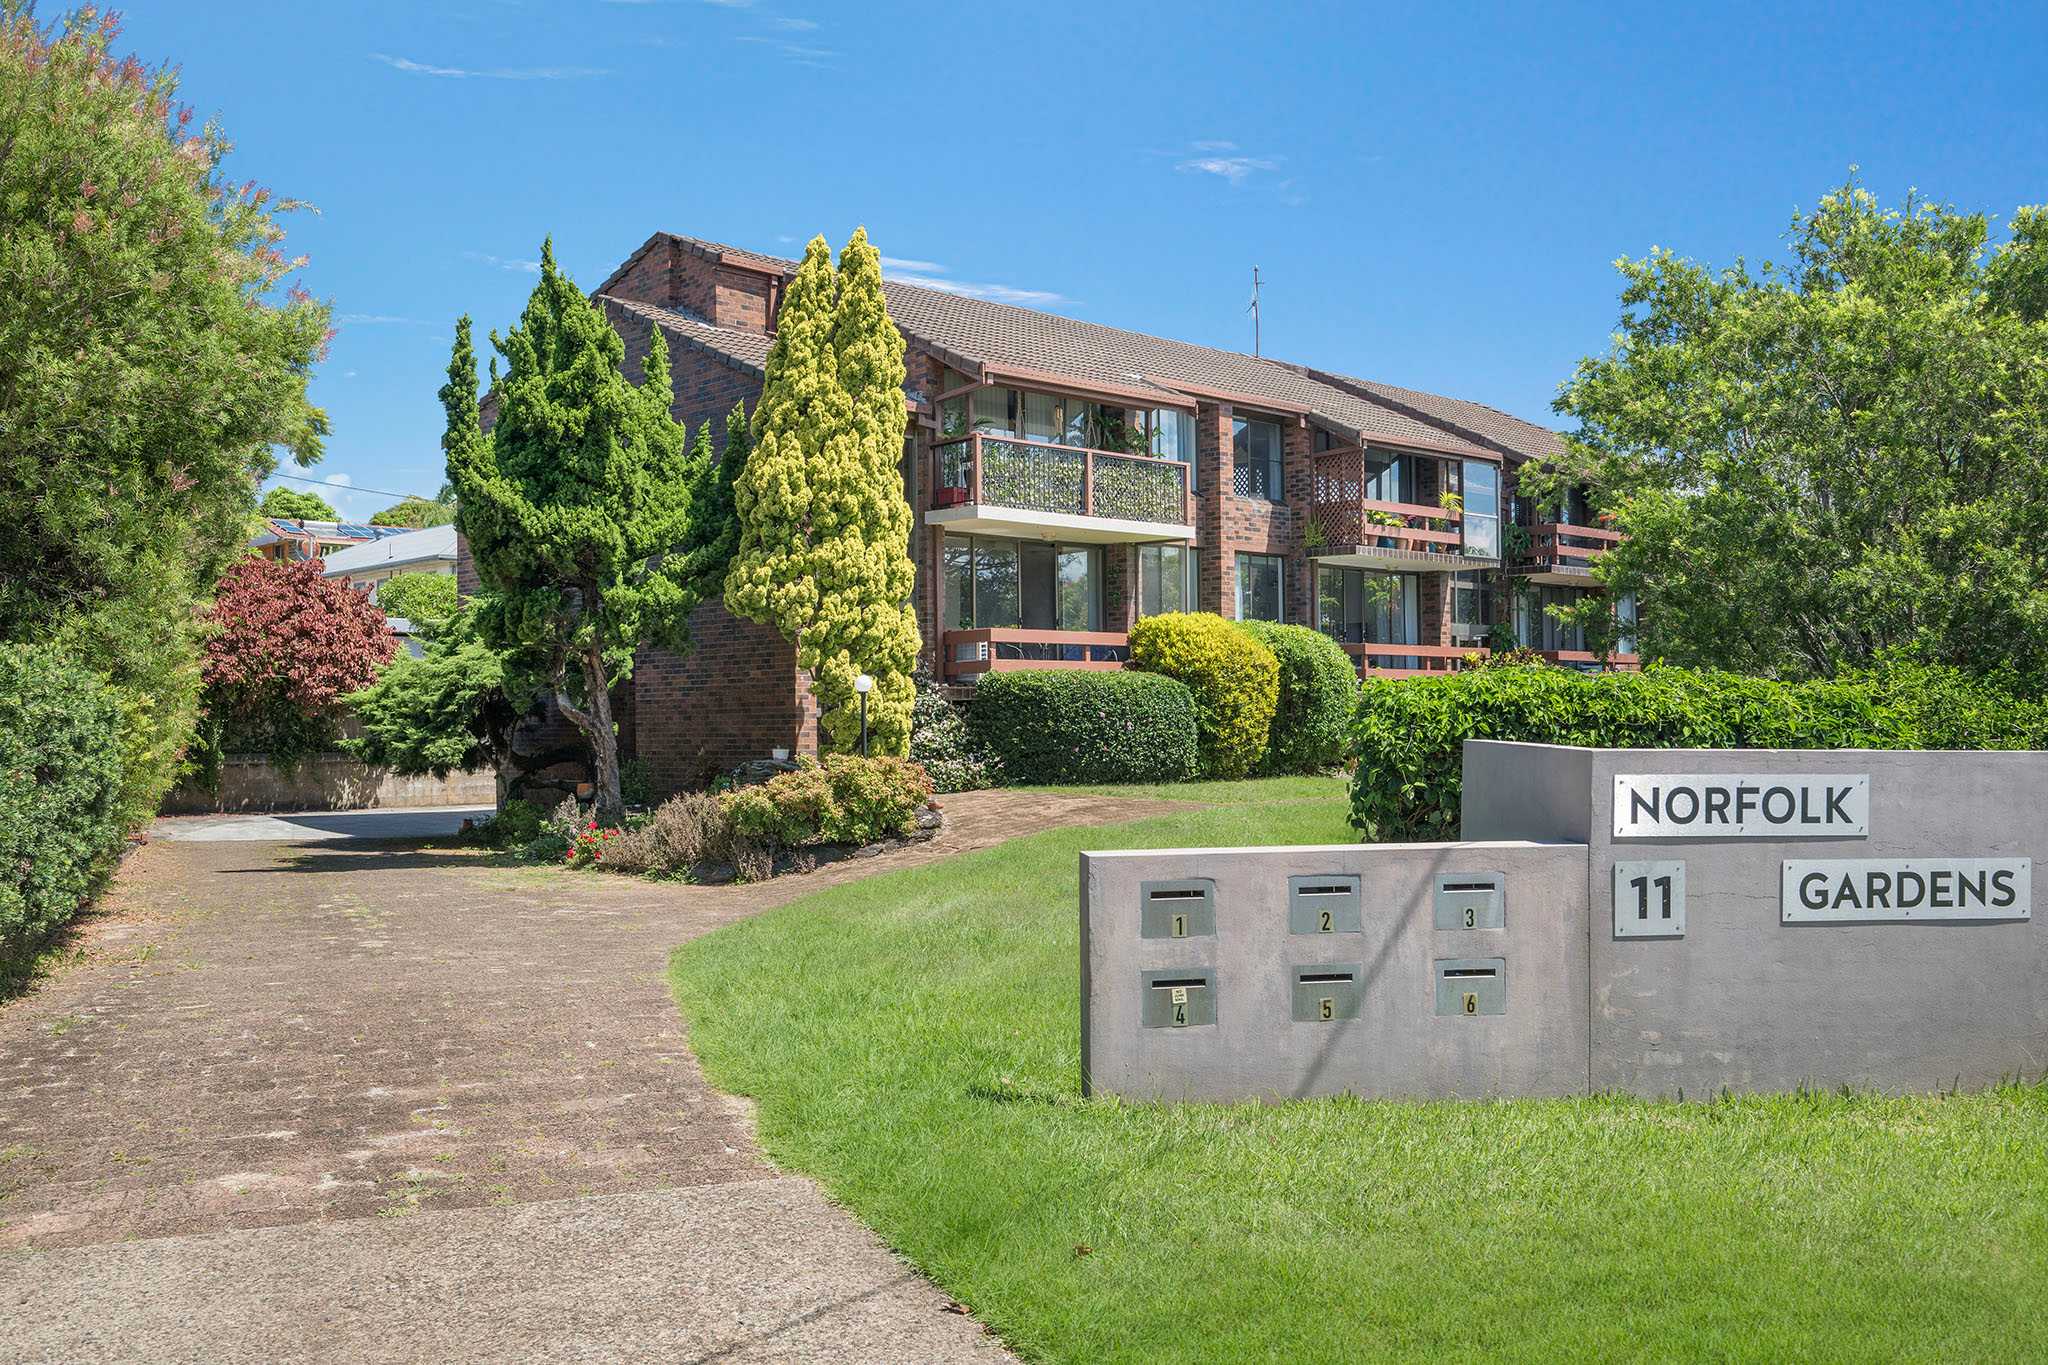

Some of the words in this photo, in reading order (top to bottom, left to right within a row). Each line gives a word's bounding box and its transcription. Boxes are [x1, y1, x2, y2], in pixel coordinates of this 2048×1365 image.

[1631, 786, 1853, 825] NORFOLK
[1630, 876, 1671, 919] 11
[1799, 869, 2016, 910] GARDENS
[1175, 916, 1182, 935] 1
[1320, 912, 1331, 931] 2
[1464, 908, 1474, 928] 3
[1322, 999, 1332, 1018] 5
[1466, 994, 1476, 1013] 6
[1175, 1005, 1185, 1024] 4
